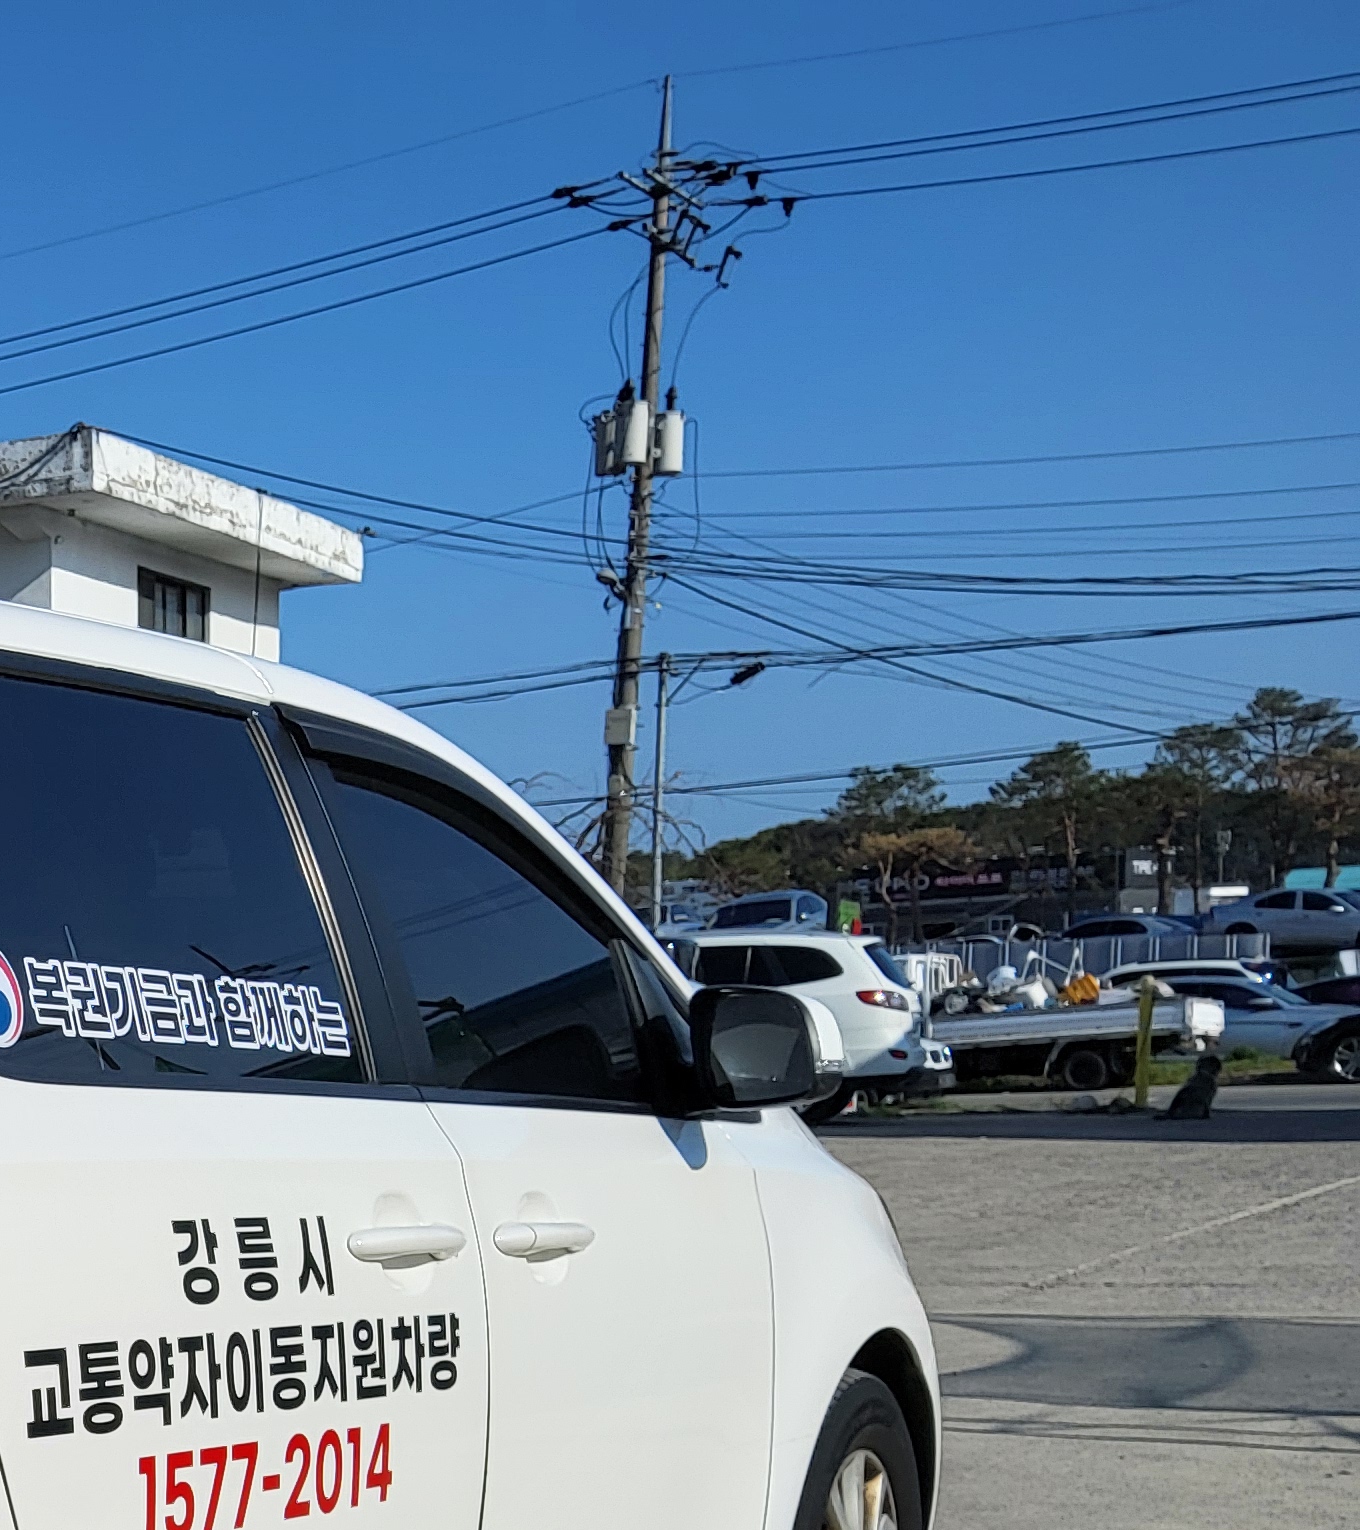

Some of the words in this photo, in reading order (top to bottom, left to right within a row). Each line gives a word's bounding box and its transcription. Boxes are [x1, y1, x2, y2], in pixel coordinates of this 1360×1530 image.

[23, 957, 218, 1047] 복권기금과
[215, 974, 351, 1058] 함께하는
[24, 1313, 460, 1438] 교통약자이동지원차량
